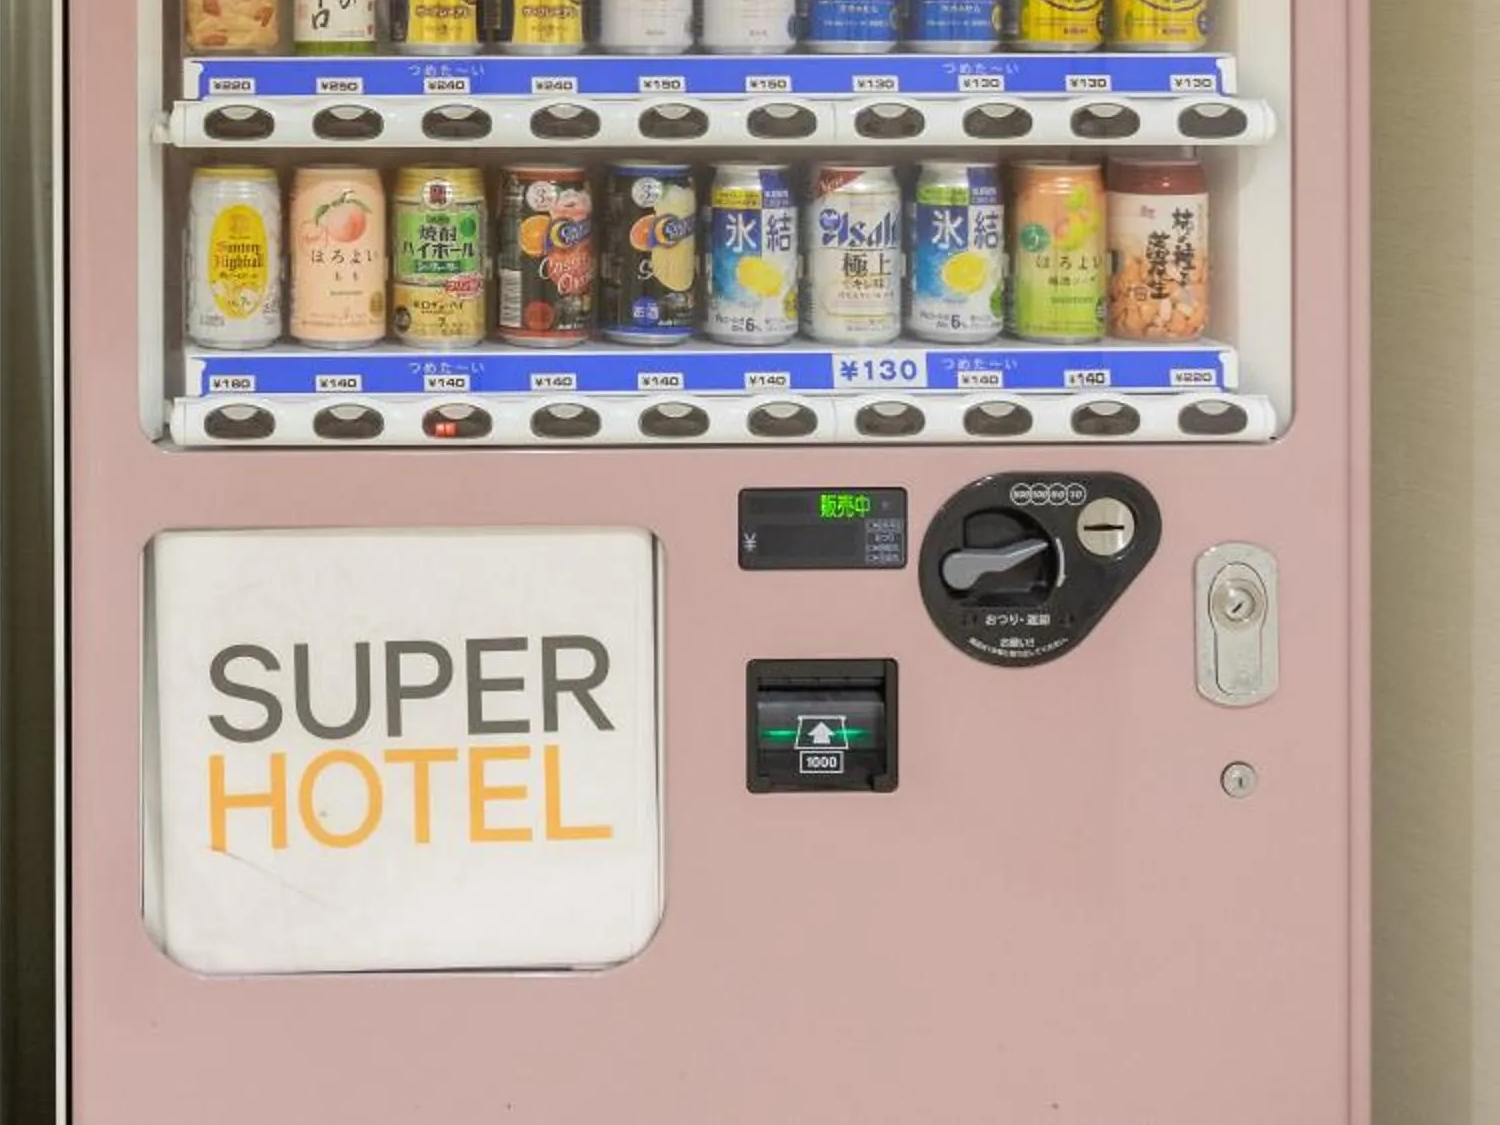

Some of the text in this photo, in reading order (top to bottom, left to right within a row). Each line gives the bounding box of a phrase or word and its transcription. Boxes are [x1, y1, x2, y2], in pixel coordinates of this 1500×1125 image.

[419, 224, 458, 241] 焼酎
[725, 213, 791, 252] 氷結
[930, 209, 999, 251] 氷結
[403, 241, 475, 259] ハイボール
[841, 252, 893, 277] 極上
[839, 360, 917, 381] ¥130
[819, 493, 871, 518] 販売中
[743, 532, 757, 552] ¥
[207, 634, 616, 744] SUPER
[806, 755, 838, 768] 1000
[208, 743, 613, 853] HOTEL
